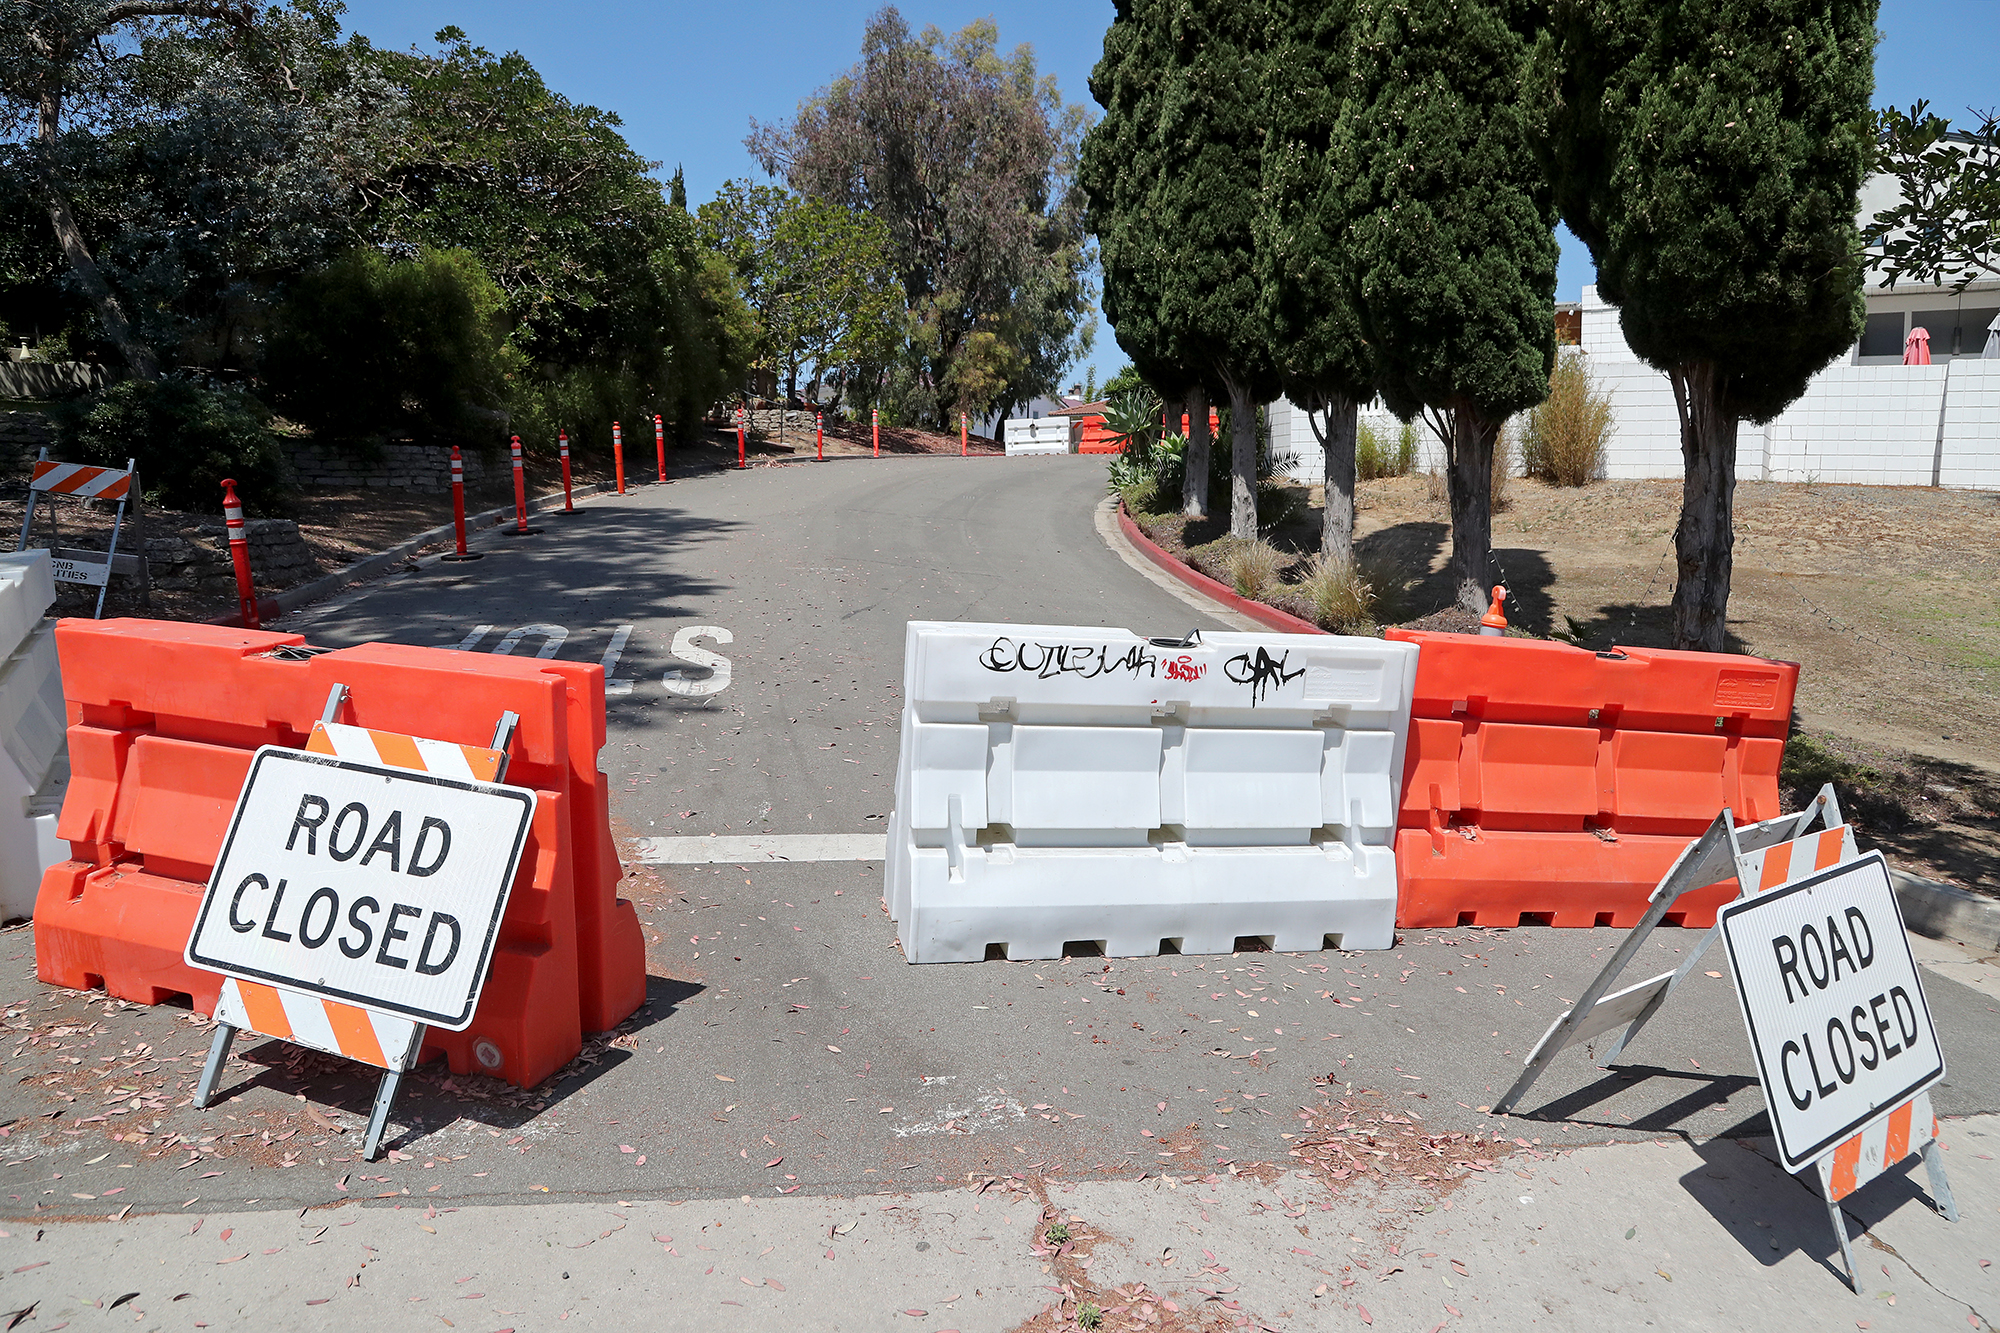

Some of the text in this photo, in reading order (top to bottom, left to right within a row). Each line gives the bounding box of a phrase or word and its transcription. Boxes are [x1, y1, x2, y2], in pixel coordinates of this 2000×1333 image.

[53, 569, 88, 580] ITIES
[285, 793, 452, 878] ROAD
[229, 872, 462, 976] CLOSED
[1771, 905, 1874, 1005] ROAD
[1780, 985, 1918, 1111] CLOSED
